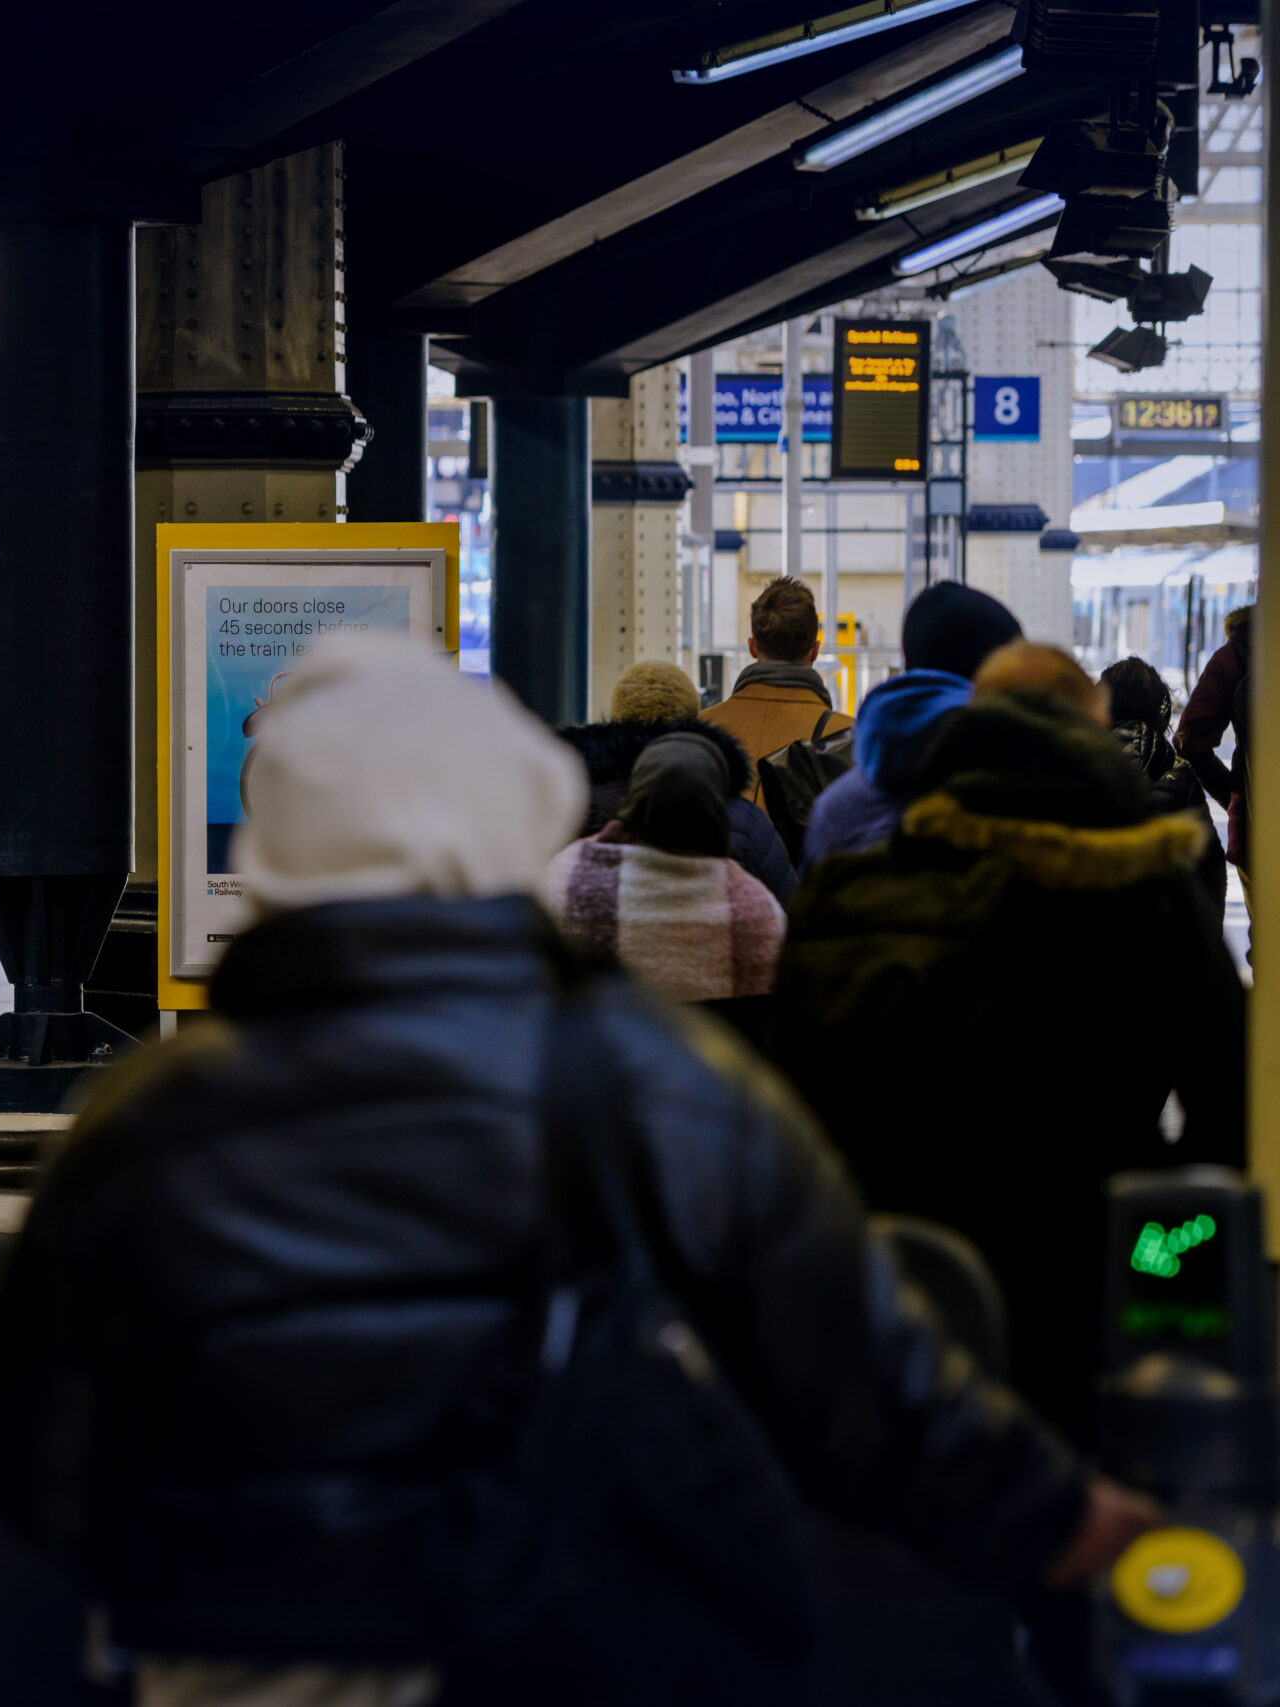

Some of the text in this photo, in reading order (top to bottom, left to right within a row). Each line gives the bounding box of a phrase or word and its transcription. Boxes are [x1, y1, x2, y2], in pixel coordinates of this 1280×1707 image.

[994, 386, 1020, 425] 8
[219, 597, 345, 614] Our doors close
[219, 620, 369, 635] 45 seconds before
[219, 641, 246, 657] the
[251, 641, 287, 657] train
[207, 880, 229, 889] South
[214, 888, 243, 898] Railway
